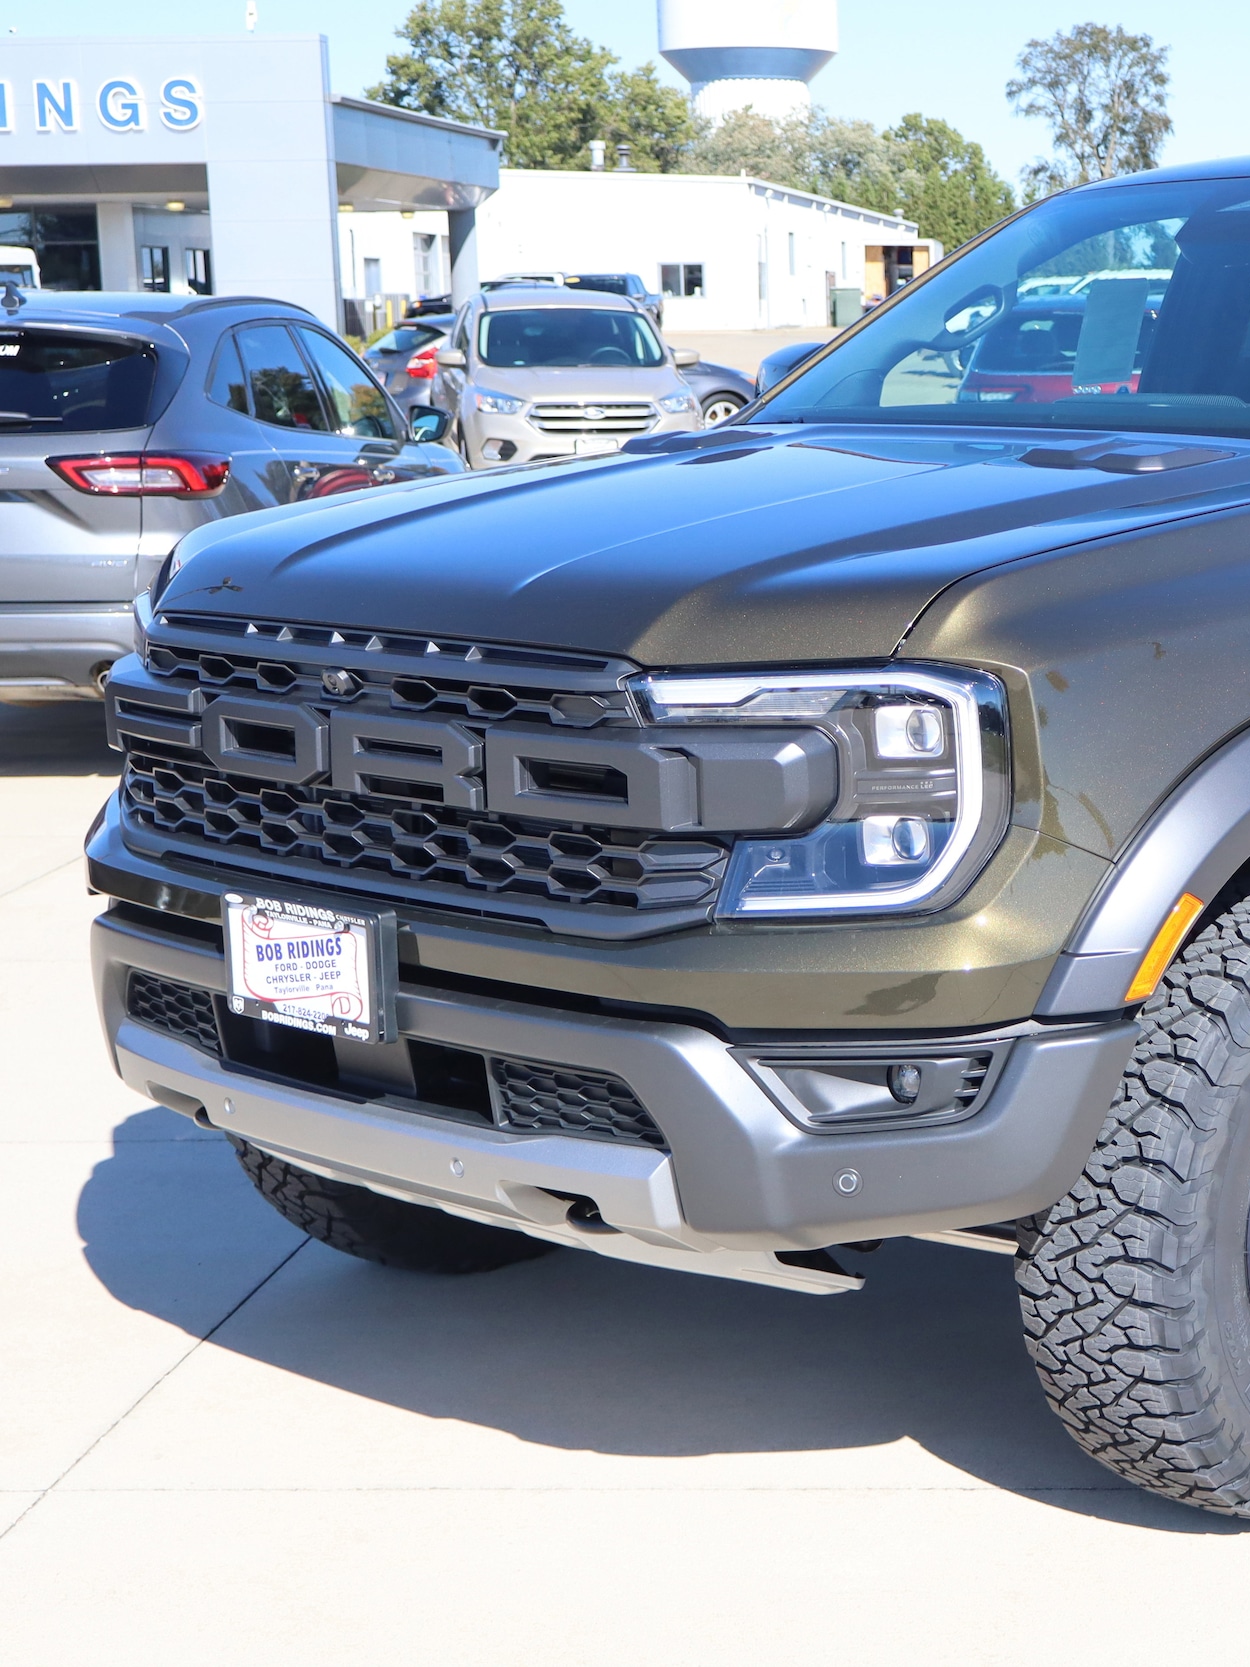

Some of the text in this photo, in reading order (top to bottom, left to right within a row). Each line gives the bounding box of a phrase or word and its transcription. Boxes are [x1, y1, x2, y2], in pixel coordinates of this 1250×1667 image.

[105, 655, 698, 832] FORD
[256, 897, 336, 922] BOB RIDINGS
[265, 910, 308, 924] TAYLORVILLE
[313, 920, 332, 929] PANA
[256, 936, 342, 962] BOB RIDINGS
[275, 962, 298, 972] FORD
[305, 960, 337, 970] DODGE
[266, 971, 311, 984] CHRYSLER
[319, 971, 341, 981] JEEP
[274, 984, 310, 995] Taylorville
[262, 1010, 337, 1036] BOBRIDINGS.COM
[344, 1023, 370, 1041] Jeep
